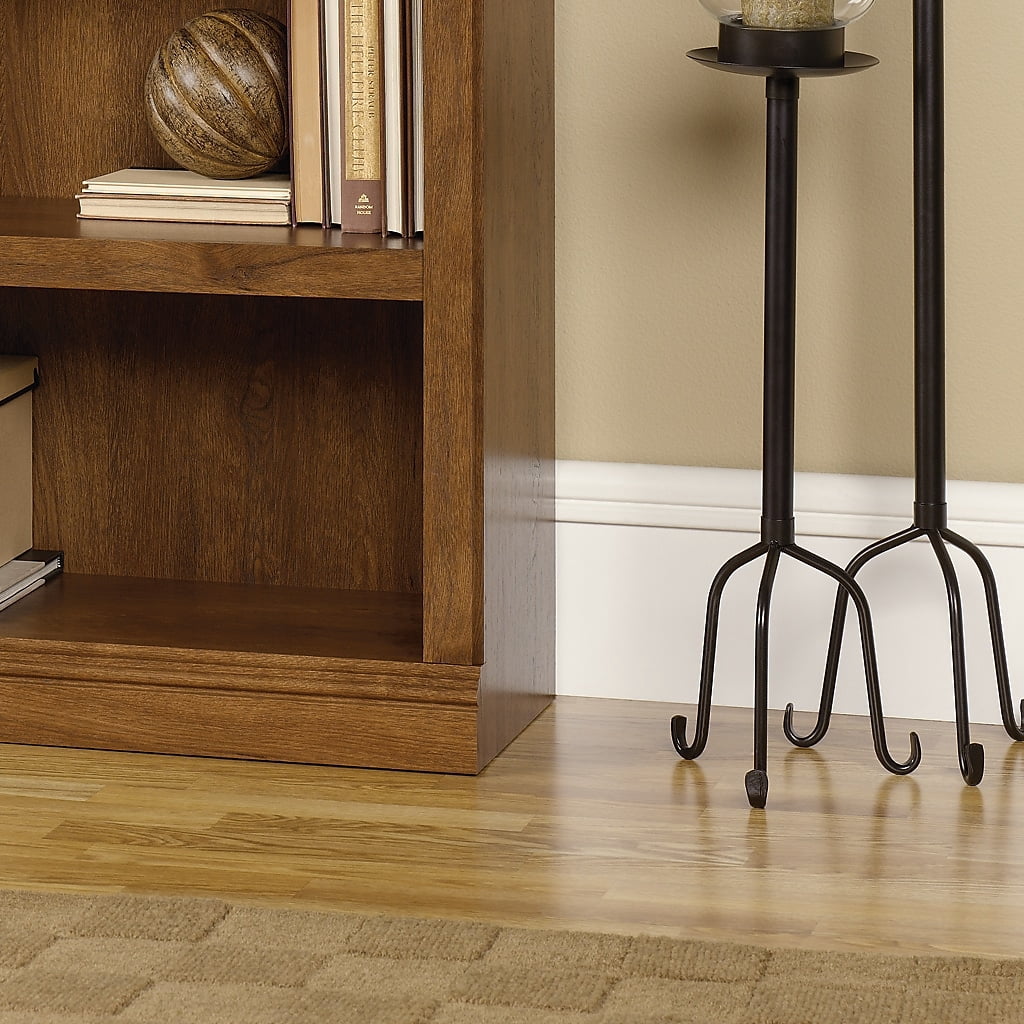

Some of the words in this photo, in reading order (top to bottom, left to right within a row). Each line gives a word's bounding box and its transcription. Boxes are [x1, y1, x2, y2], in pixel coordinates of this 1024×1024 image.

[351, 34, 365, 119] HELLFIRE
[367, 45, 375, 77] PETER
[367, 80, 375, 119] STRAUB
[351, 124, 365, 173] CLUB
